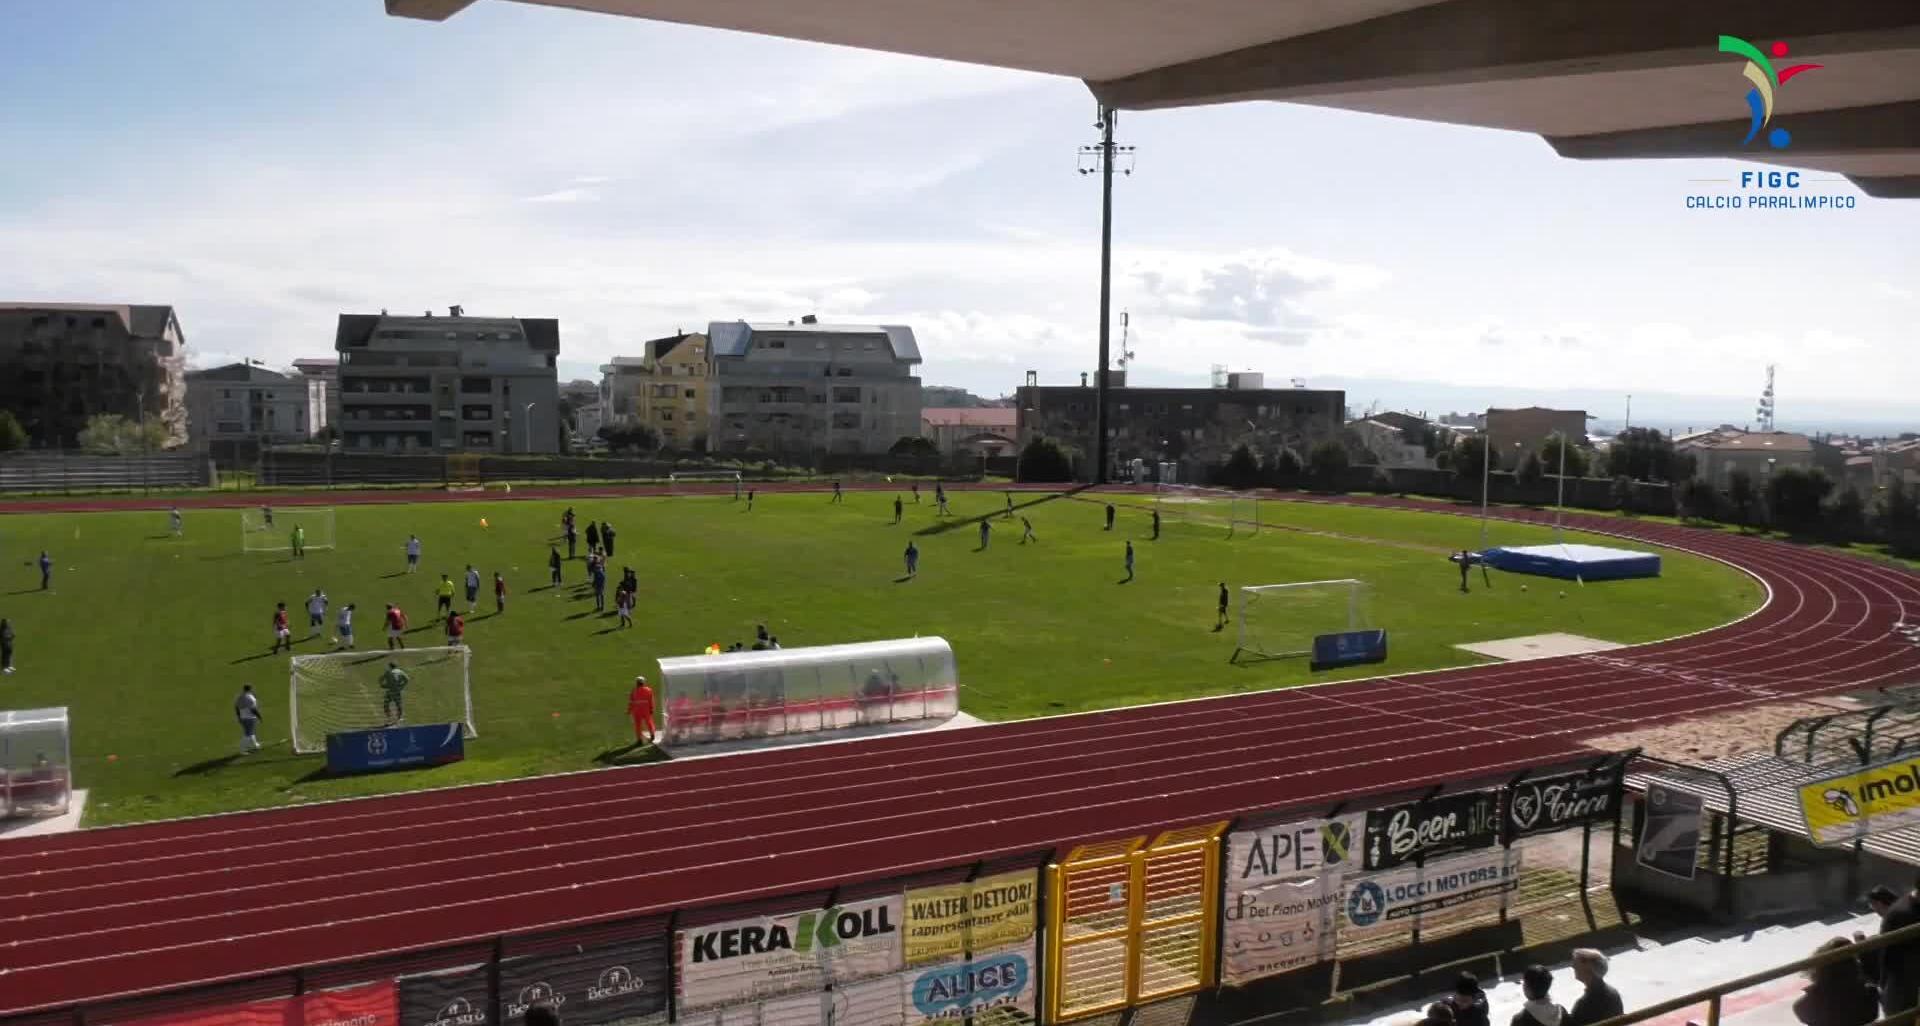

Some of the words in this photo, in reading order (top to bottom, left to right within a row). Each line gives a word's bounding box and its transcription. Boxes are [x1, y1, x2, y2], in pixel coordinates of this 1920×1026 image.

[1241, 820, 1352, 879] APEX
[911, 896, 968, 920] WALTER
[973, 882, 1032, 911] DETTORI
[1386, 880, 1432, 903] LOCCI
[1436, 866, 1498, 892] MOTORS
[692, 904, 896, 963] KERAKOLL
[925, 962, 1017, 1003] ALICE
